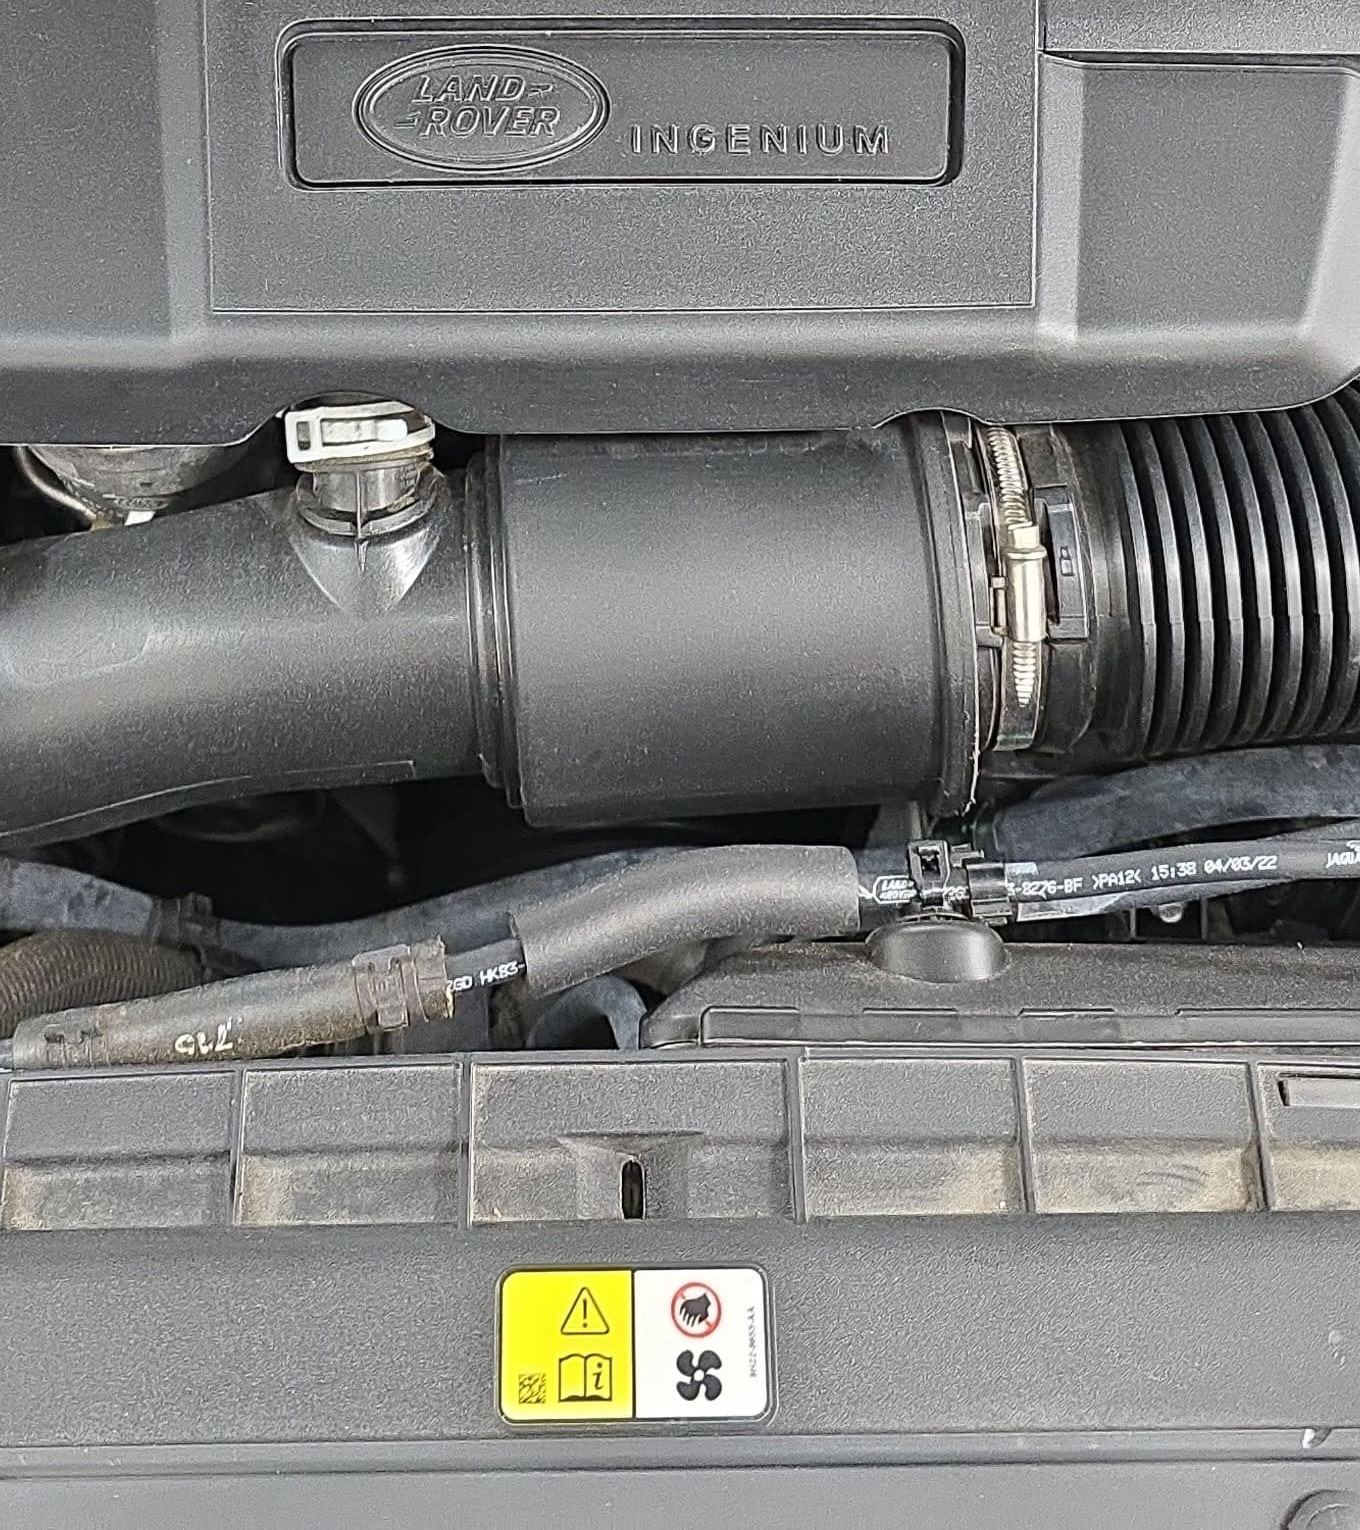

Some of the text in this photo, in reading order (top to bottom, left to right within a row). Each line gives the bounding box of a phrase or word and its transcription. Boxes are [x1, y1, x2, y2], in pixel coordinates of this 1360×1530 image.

[412, 74, 524, 103] LAND
[419, 105, 890, 155] ROVER INGENIUM
